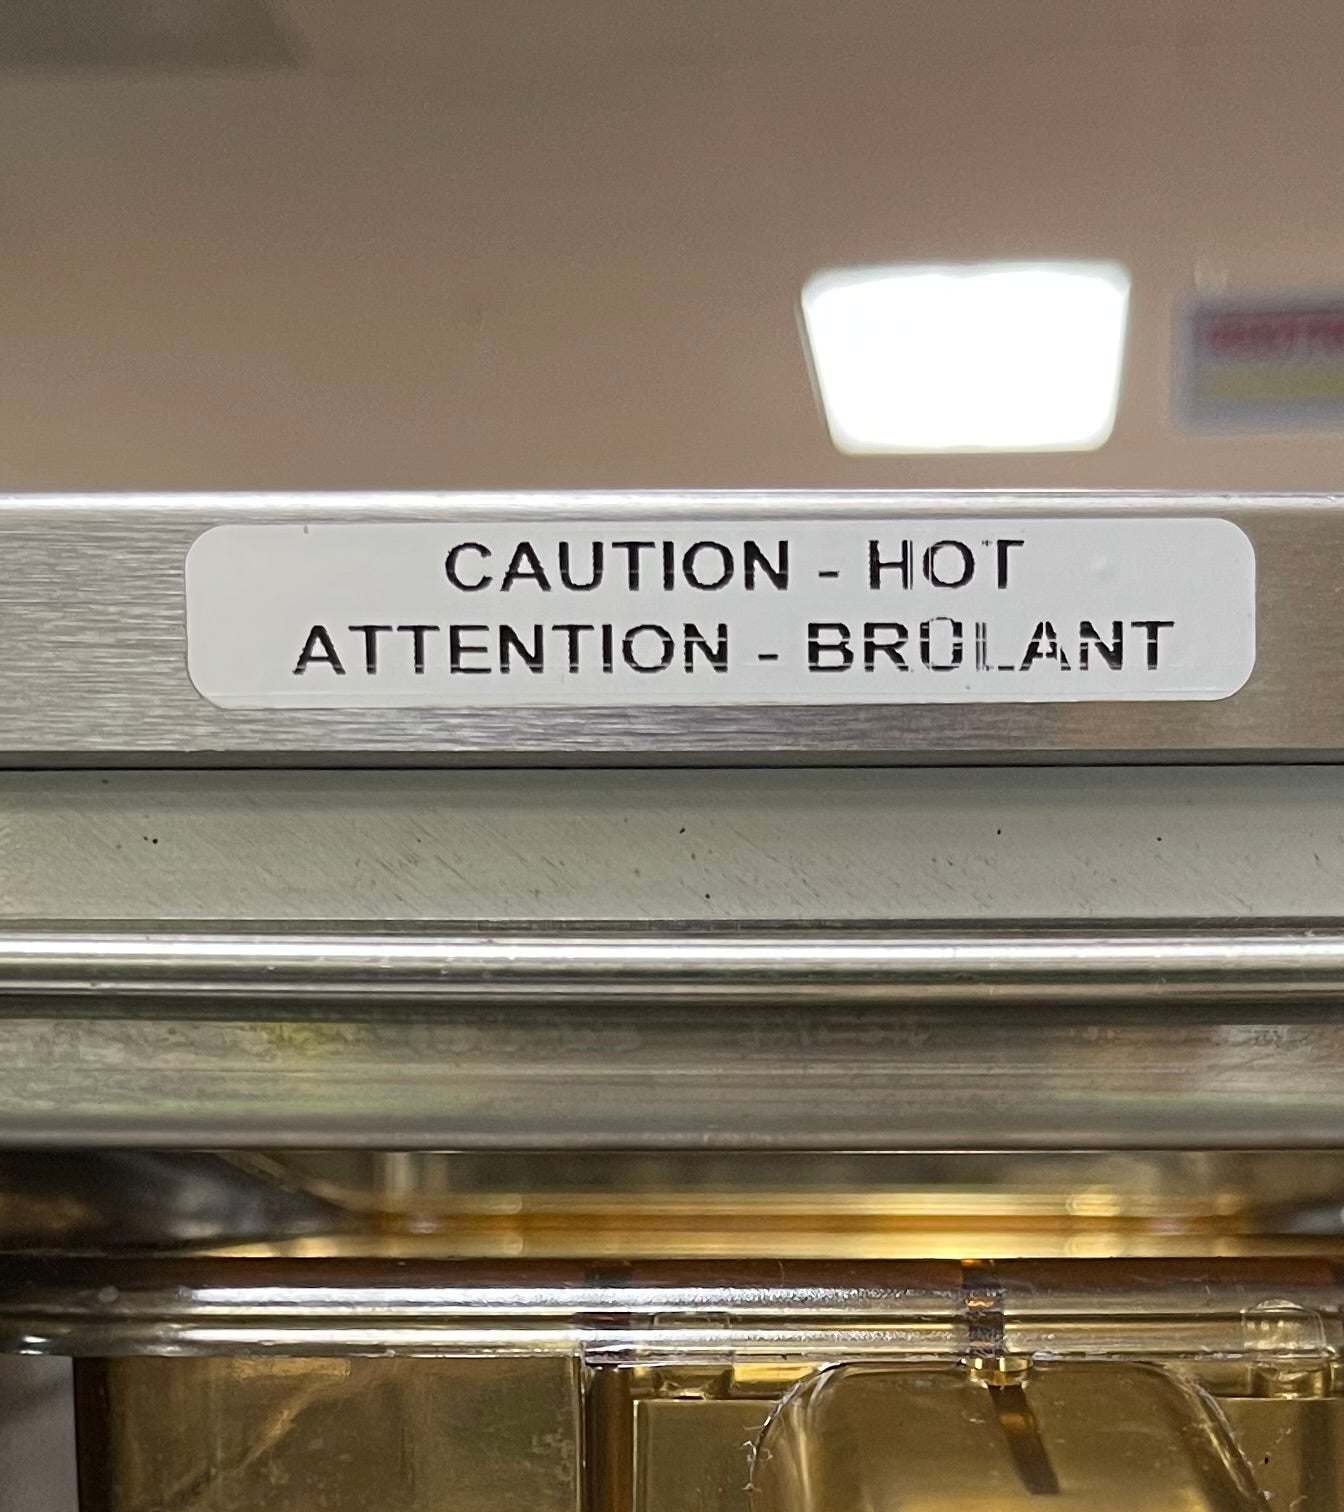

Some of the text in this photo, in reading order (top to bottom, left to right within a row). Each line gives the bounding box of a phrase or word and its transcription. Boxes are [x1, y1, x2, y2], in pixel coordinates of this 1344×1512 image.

[444, 539, 1025, 592] CAUTION - HOT
[292, 623, 728, 675] ATTENTION
[757, 653, 779, 661] -
